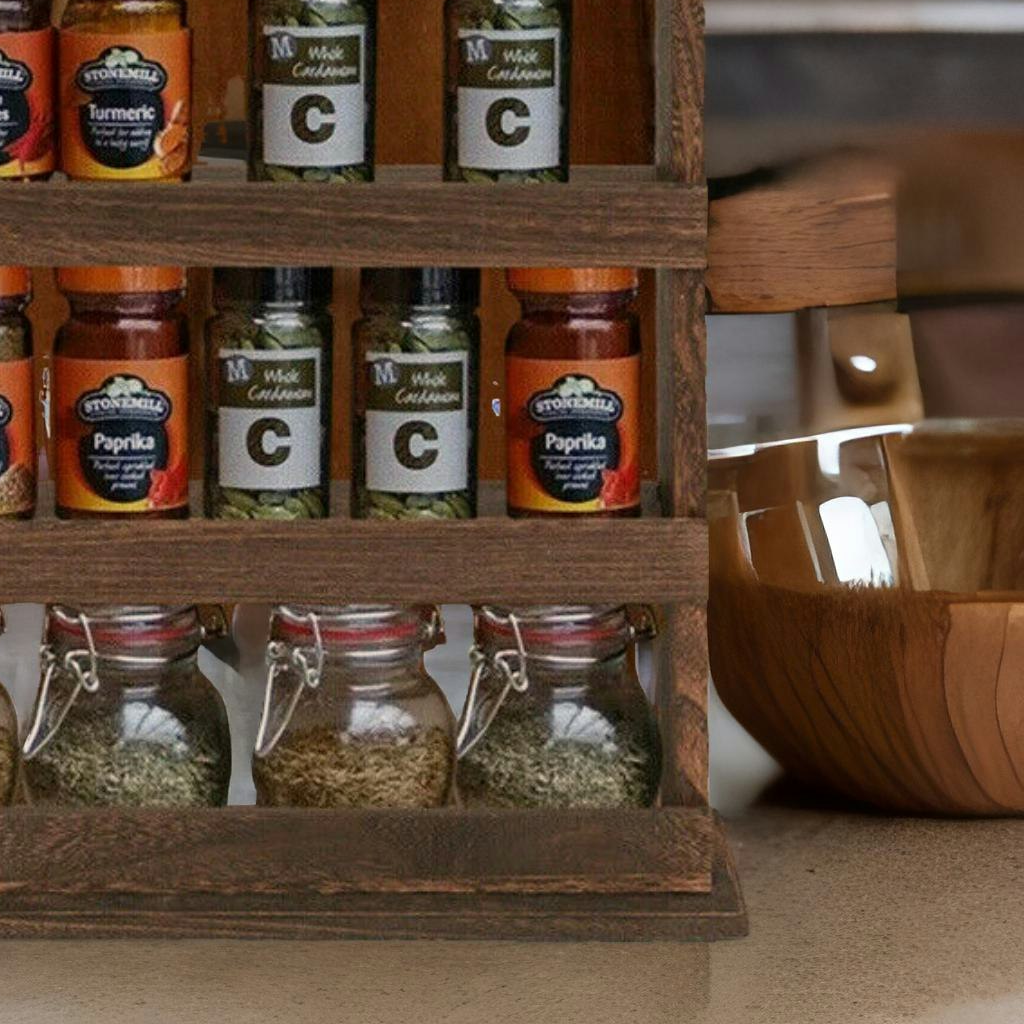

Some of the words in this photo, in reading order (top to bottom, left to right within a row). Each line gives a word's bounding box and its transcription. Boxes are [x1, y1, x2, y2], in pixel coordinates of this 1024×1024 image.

[269, 34, 295, 59] M
[308, 44, 345, 62] Whole
[466, 37, 489, 62] M
[503, 47, 540, 65] Whole
[83, 67, 160, 83] STONEMILL
[89, 103, 156, 121] Turmeric
[290, 94, 336, 145] C
[485, 96, 530, 147] C
[226, 358, 249, 384] M
[264, 369, 299, 385] Whole
[373, 362, 397, 385] M
[411, 371, 447, 387] Whole
[84, 398, 165, 414] STONEMILL
[535, 397, 615, 414] STONEMILL
[93, 432, 155, 455] Paprika
[246, 417, 291, 467] C
[393, 420, 438, 470] C
[545, 432, 606, 455] Paprika
